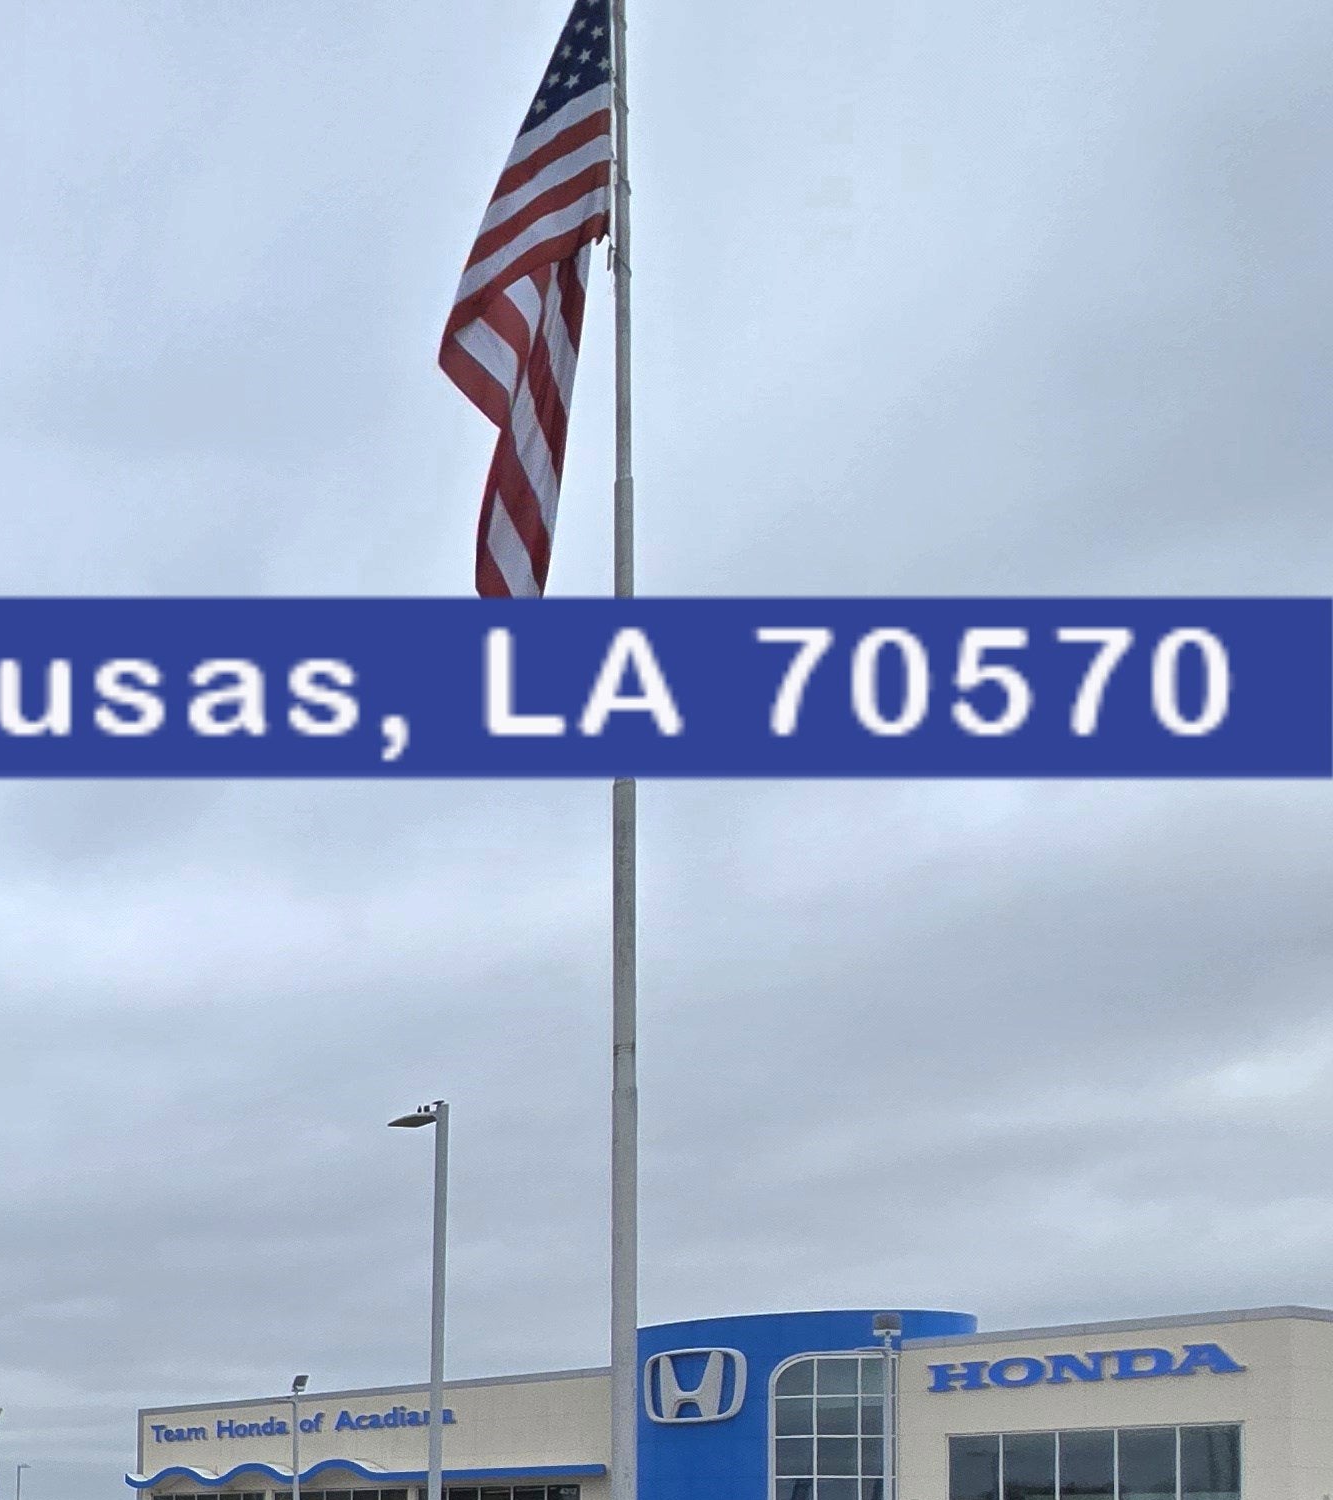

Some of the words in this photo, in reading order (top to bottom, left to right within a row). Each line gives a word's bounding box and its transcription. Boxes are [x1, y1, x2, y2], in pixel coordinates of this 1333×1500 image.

[927, 1343, 1246, 1392] HONDA
[151, 1424, 209, 1443] Team
[216, 1415, 290, 1438] Honda
[299, 1412, 326, 1434] of
